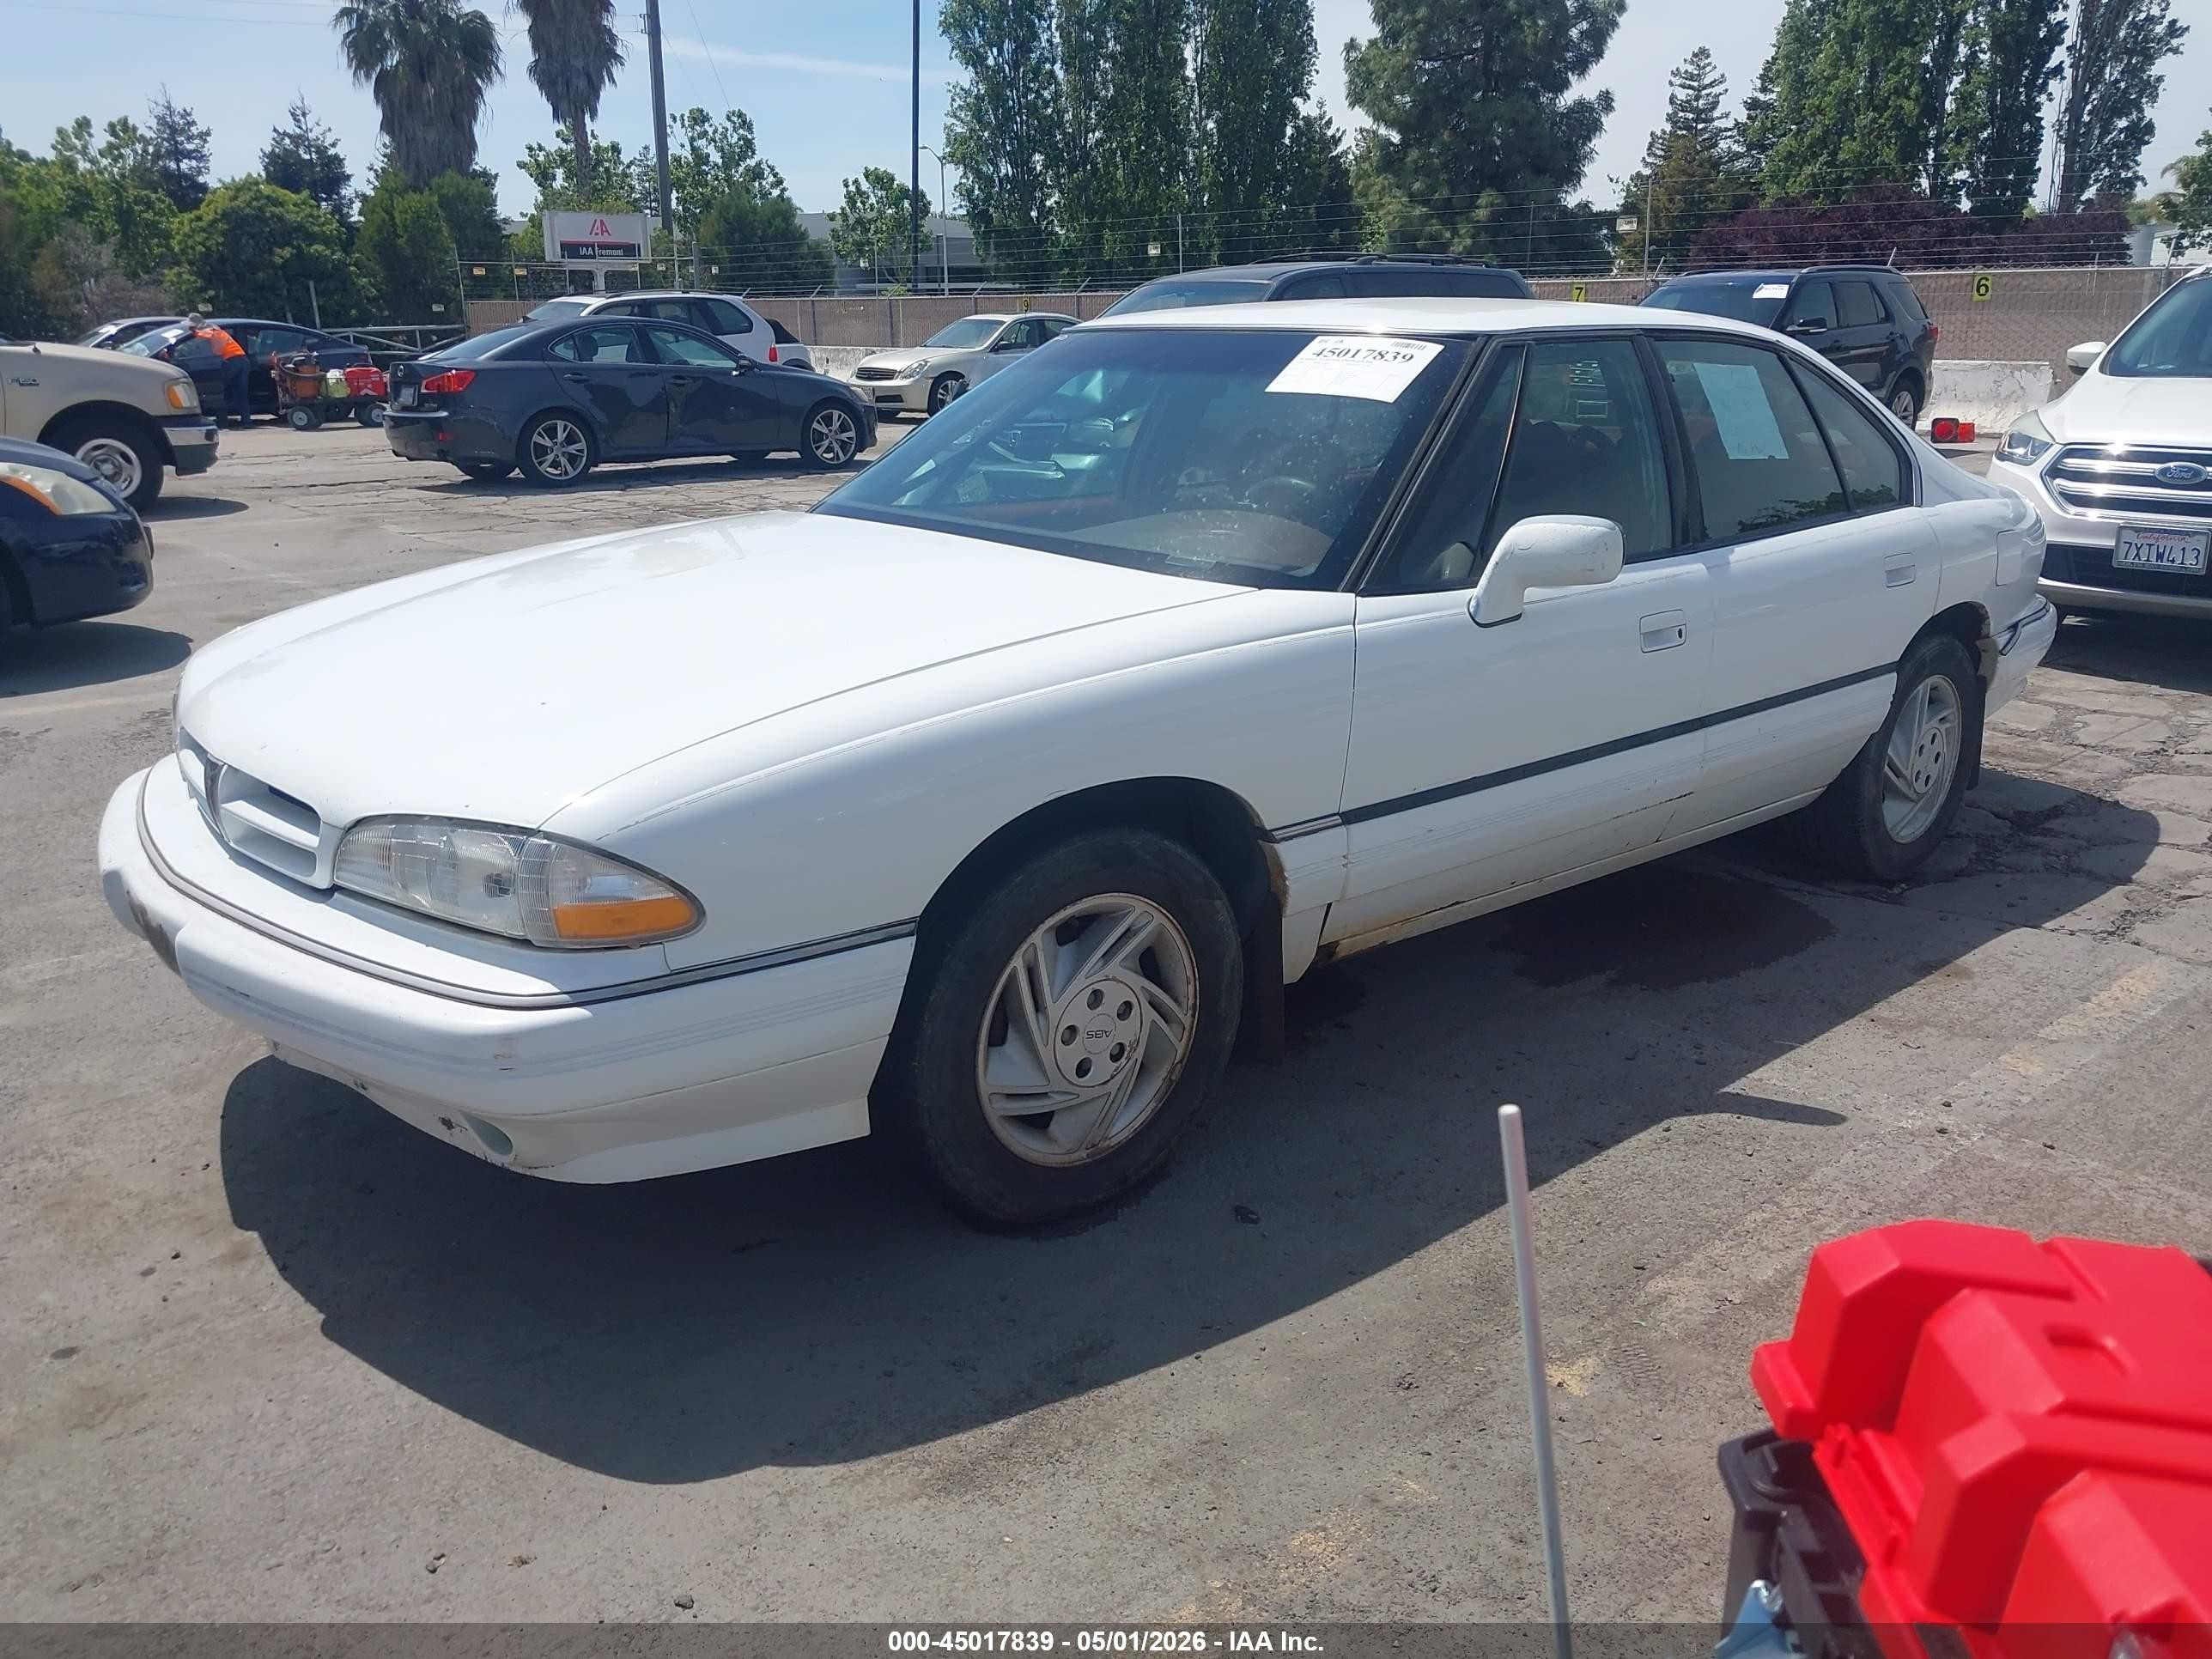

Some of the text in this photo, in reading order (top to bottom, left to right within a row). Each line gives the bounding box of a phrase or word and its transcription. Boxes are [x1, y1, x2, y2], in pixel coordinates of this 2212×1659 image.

[579, 246, 594, 256] IAA
[1976, 276, 1990, 297] 6
[1575, 287, 1584, 302] 7
[1023, 299, 1029, 313] 9
[1312, 347, 1414, 364] 45017839
[2166, 466, 2195, 479] Ford
[2136, 532, 2191, 544] California
[2122, 541, 2201, 567] 7XIW413
[1085, 1029, 1114, 1040] ABS
